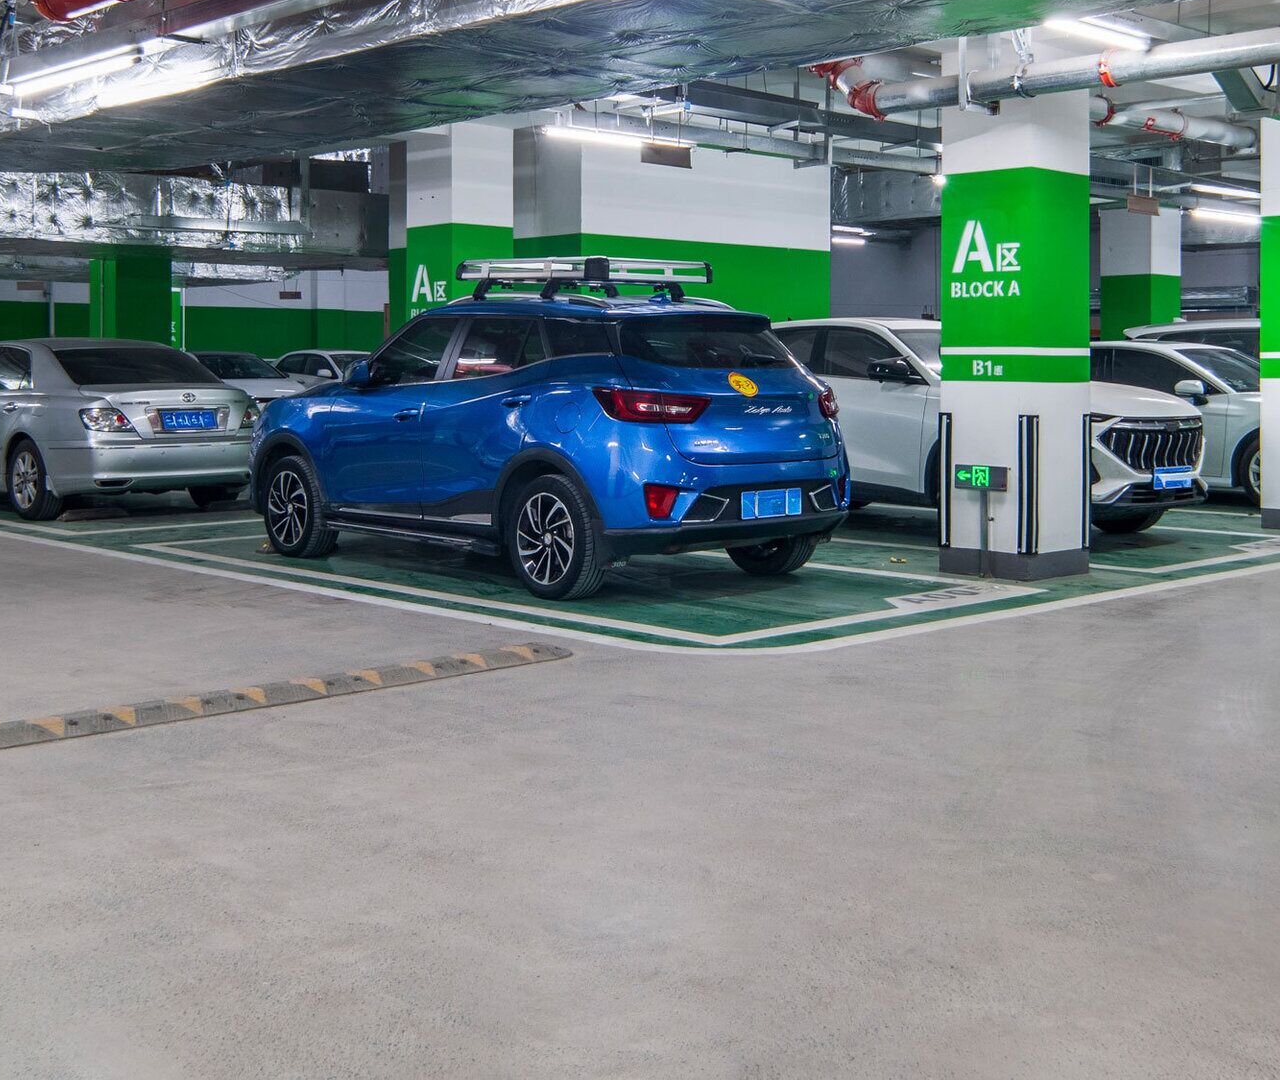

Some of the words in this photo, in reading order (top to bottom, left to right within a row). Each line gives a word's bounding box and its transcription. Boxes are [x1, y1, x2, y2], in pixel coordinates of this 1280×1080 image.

[951, 219, 1022, 273] A区
[950, 281, 1005, 298] BLOCK
[1007, 280, 1021, 297] A
